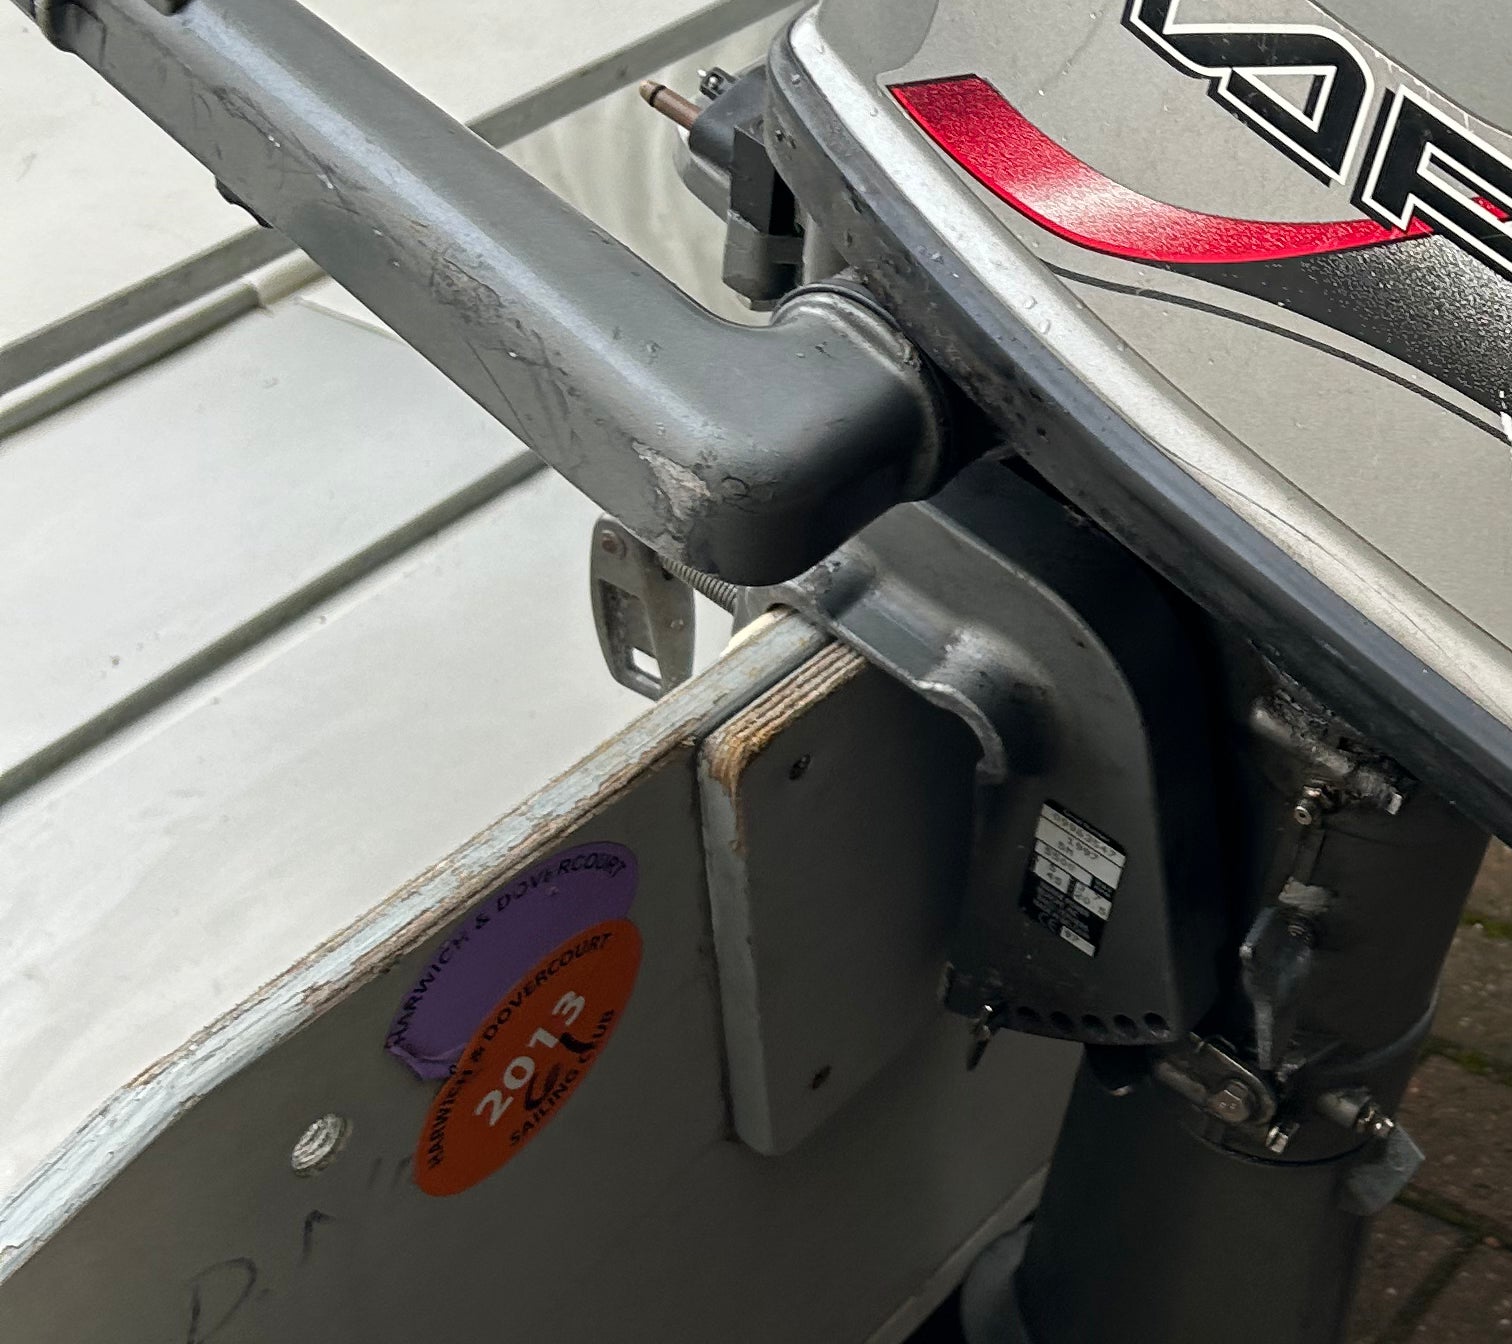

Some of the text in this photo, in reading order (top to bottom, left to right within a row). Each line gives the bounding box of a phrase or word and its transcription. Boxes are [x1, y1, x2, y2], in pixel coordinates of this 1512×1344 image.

[495, 851, 627, 911] DOVERCOURT
[482, 931, 614, 1040] DOVERCOURT
[473, 990, 586, 1126] 2013
[508, 1067, 579, 1147] SAILING
